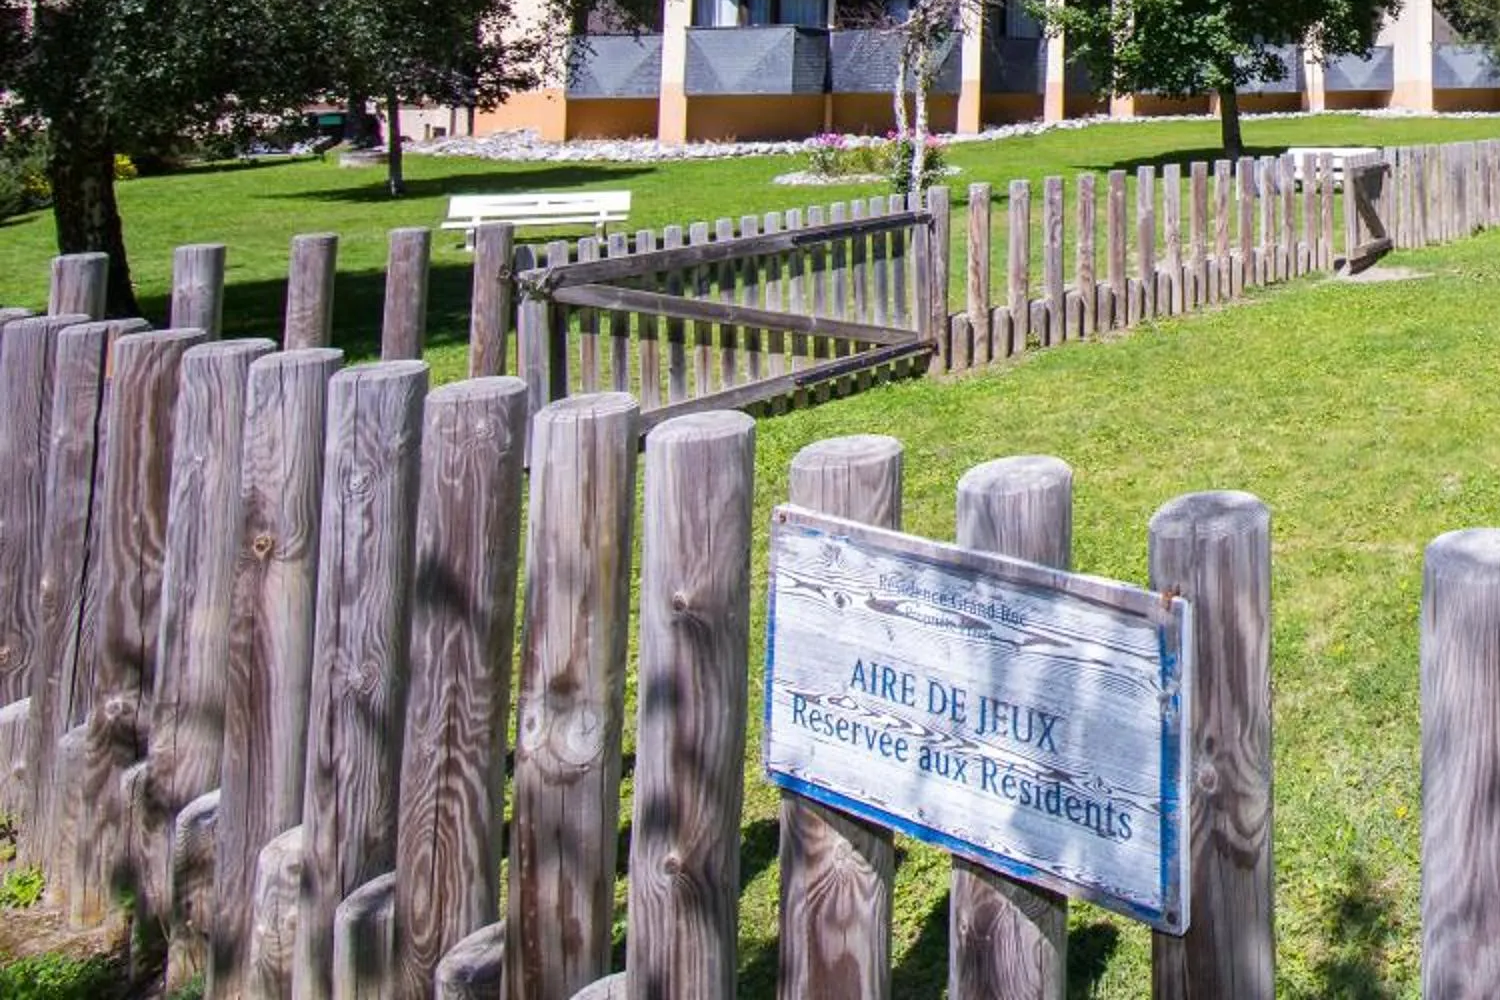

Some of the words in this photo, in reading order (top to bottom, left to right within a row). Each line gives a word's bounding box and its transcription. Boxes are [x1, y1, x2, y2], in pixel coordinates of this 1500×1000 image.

[849, 657, 917, 708] AIRE
[926, 679, 968, 724] DE
[974, 695, 1061, 755] JEUX
[918, 743, 968, 784] aux
[980, 755, 1133, 841] Résidents
